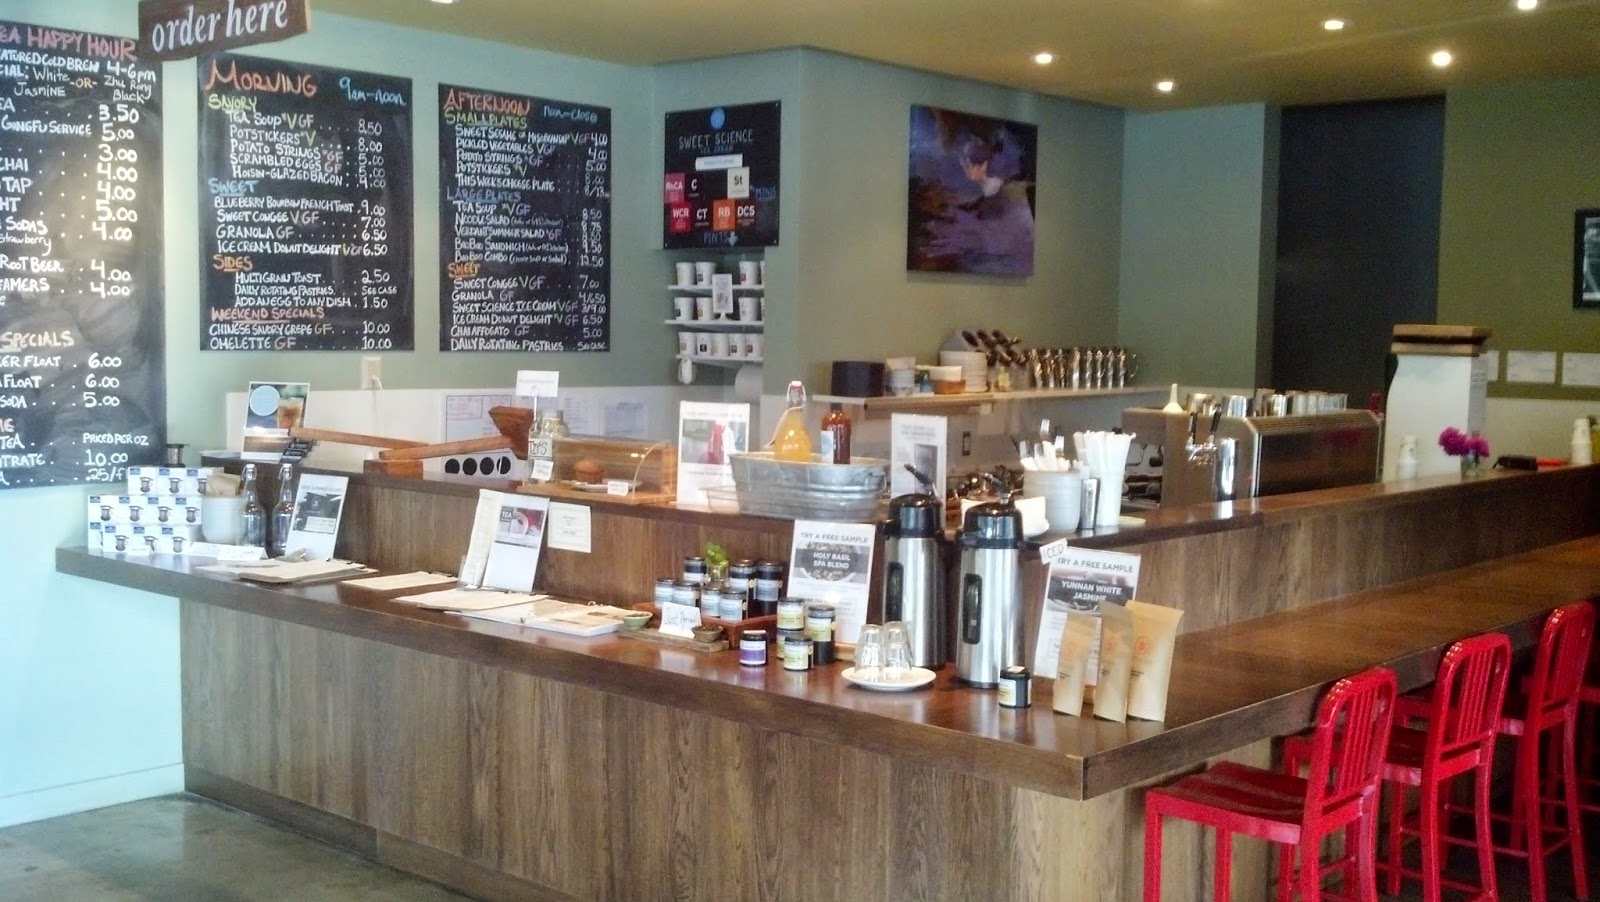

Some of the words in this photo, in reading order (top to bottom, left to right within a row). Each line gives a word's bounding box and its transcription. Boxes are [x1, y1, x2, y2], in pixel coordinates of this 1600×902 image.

[152, 5, 221, 52] order
[226, 0, 288, 37] here
[28, 26, 84, 53] HAPPY
[87, 33, 138, 61] HOUR
[33, 66, 70, 82] White
[206, 59, 317, 97] MORNING
[113, 89, 145, 104] Black
[208, 93, 257, 112] SAVORY
[443, 88, 530, 116] AFTERNOON
[99, 104, 139, 124] 3.50
[225, 110, 250, 124] TEA
[359, 118, 382, 136] 8.50
[455, 124, 487, 138] SWEET
[101, 122, 135, 141] 5.00
[230, 124, 300, 145] POTSTICKERS
[359, 137, 383, 153] 8.00
[678, 133, 711, 149] SWEET
[715, 129, 754, 145] SCIENCE
[98, 143, 137, 162] 3.00
[230, 139, 270, 153] POTATO
[275, 143, 321, 159] STRINGS
[359, 153, 384, 166] 5.00
[97, 162, 138, 182] 4.00
[230, 153, 293, 167] SCRAMBLED
[295, 158, 321, 171] EGGS
[359, 165, 385, 177] 5.00
[208, 178, 259, 194] SWEET
[310, 172, 343, 186] BACON
[455, 173, 476, 187] THIS
[97, 180, 136, 201] 4.00
[96, 199, 138, 222] 5.00
[214, 196, 264, 208] BLUEBERRY
[361, 199, 386, 216] 9.00
[672, 207, 689, 218] WCR
[696, 208, 708, 220] CT
[718, 206, 730, 217] RB
[737, 205, 756, 218] DCS
[217, 209, 252, 222] SWEET
[252, 210, 289, 222] CONGEE
[361, 216, 386, 229] 7.00
[92, 221, 133, 241] 4.00
[216, 224, 274, 239] GRANOLA
[361, 229, 387, 241] 6.50
[217, 240, 236, 253] ICE
[237, 240, 272, 253] CREAM
[302, 243, 342, 255] DELIGHT
[363, 243, 388, 256] 6.50
[91, 259, 131, 281] 4.00
[213, 254, 253, 271] SIDES
[448, 262, 480, 278] SWEET
[235, 271, 290, 284] MULTIGRAIN
[291, 272, 321, 284] TOAST
[361, 268, 390, 284] 2.50
[453, 277, 487, 289] SWEET
[90, 281, 131, 299] 4.00
[234, 284, 260, 296] DAILY
[260, 285, 297, 296] ROTATING
[452, 290, 494, 301] GRANOLA
[234, 296, 255, 307] ADD
[270, 297, 292, 306] EGG
[326, 297, 351, 307] DISH
[363, 296, 388, 308] 1.50
[453, 302, 481, 313] SWEET
[481, 301, 514, 312] SCIENCE
[211, 306, 268, 321] WEEKEND
[271, 306, 325, 320] SPECIALS
[520, 314, 552, 325] DELIGHT
[582, 314, 603, 325] 6.50
[209, 324, 250, 336] CHINESE
[252, 324, 283, 335] SAVORY
[362, 320, 390, 334] 10.00
[583, 327, 603, 339] 5.00
[0, 330, 75, 349] SPECIALS
[210, 337, 271, 349] OMELETTE
[361, 336, 392, 350] 10.00
[451, 338, 478, 351] DAILY
[478, 338, 520, 350] ROTATING
[523, 340, 564, 352] PASTRIES
[23, 355, 61, 368] FLOAT
[88, 352, 122, 369] 6.00
[3, 374, 42, 388] FLOAT
[85, 373, 120, 389] 6.00
[83, 391, 120, 408] 5.00
[82, 432, 114, 444] PRICED
[114, 433, 133, 445] PER
[84, 448, 128, 467] 10.00
[501, 510, 512, 518] TEA
[822, 533, 839, 541] FREE
[841, 535, 868, 543] SAMPLE
[827, 561, 849, 569] BLEND
[832, 553, 851, 561] BASIL
[1081, 560, 1100, 569] FREE
[1102, 562, 1134, 572] SAMPLE
[1061, 580, 1095, 591] YUNNAN
[1096, 584, 1122, 595] WHITE
